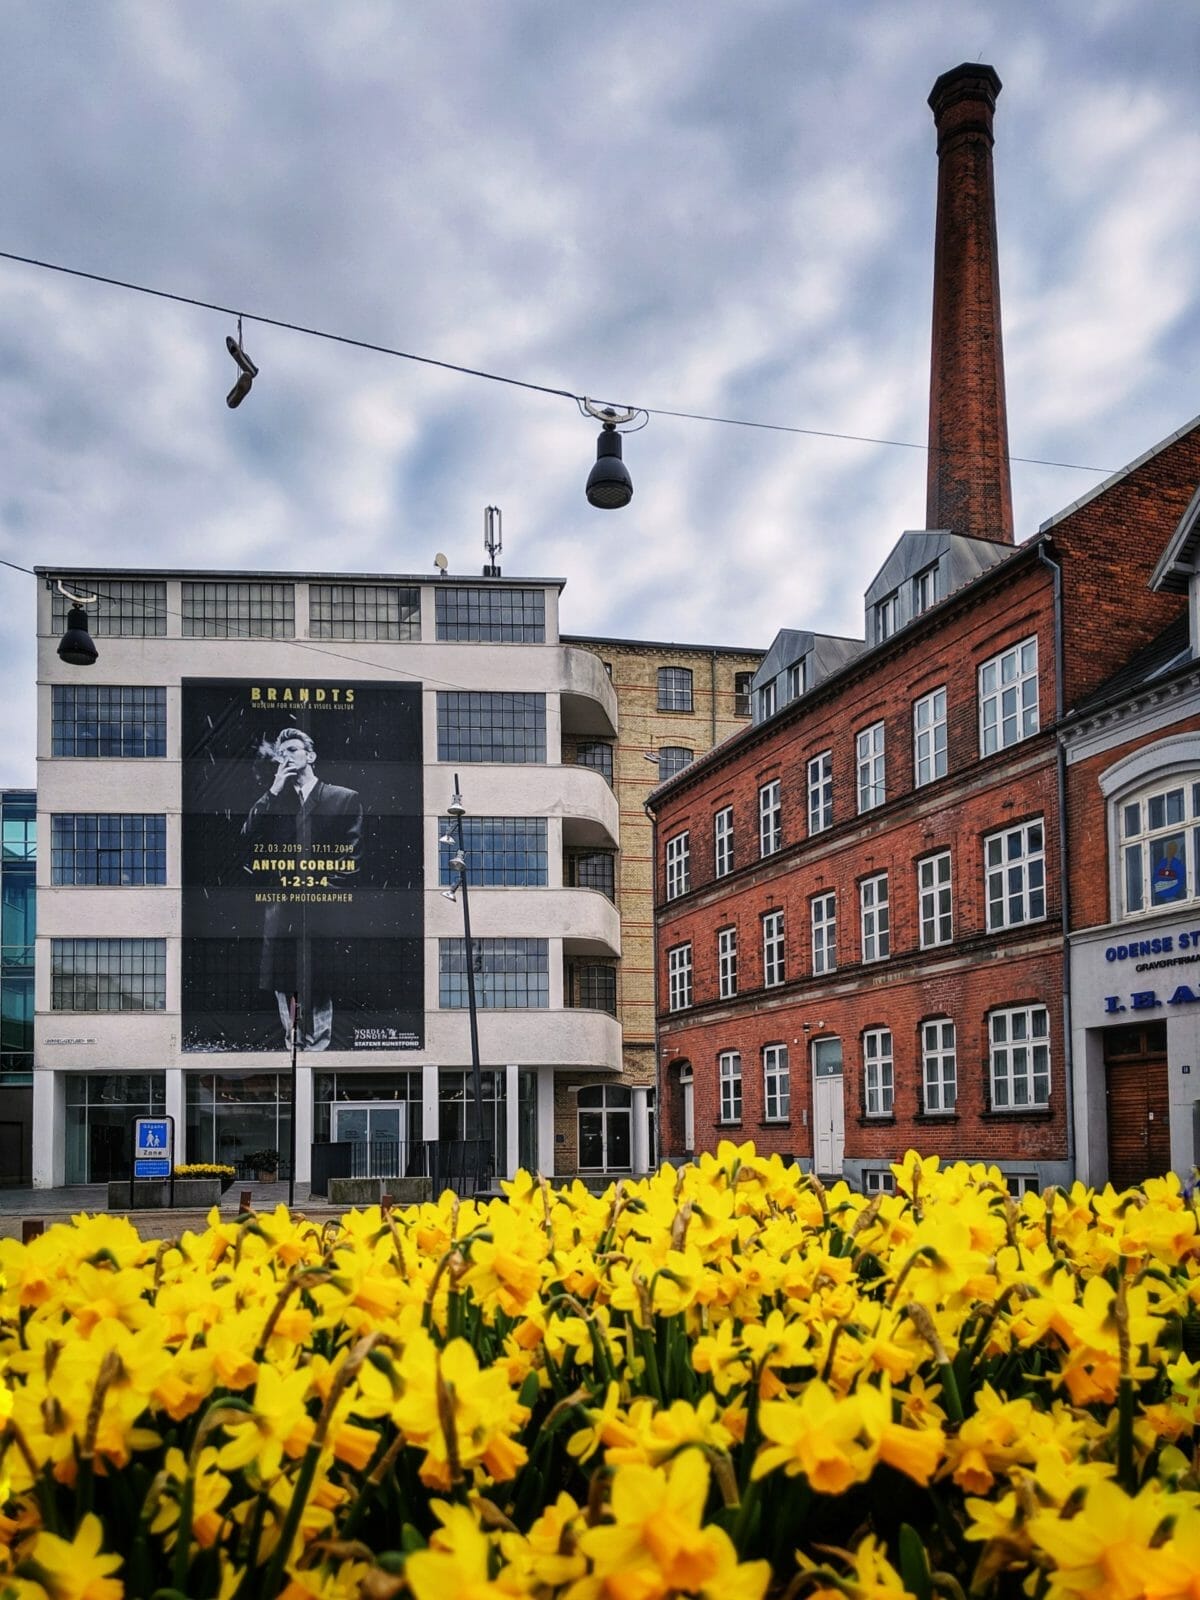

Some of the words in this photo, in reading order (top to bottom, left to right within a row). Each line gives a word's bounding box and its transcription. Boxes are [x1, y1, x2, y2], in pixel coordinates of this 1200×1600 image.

[251, 687, 354, 702] BRANDTS
[254, 844, 302, 853] 22.03.2019
[312, 844, 354, 853] 17.11.2019
[252, 859, 295, 870] ANTON
[299, 860, 355, 871] CORBIJN
[280, 876, 328, 887] 1-2-3-4
[255, 893, 288, 902] MASTER
[290, 893, 353, 902] PHOTOGRAPHER
[1105, 936, 1173, 962] ODENSE
[1178, 930, 1200, 949] ST
[1167, 984, 1200, 1004] A
